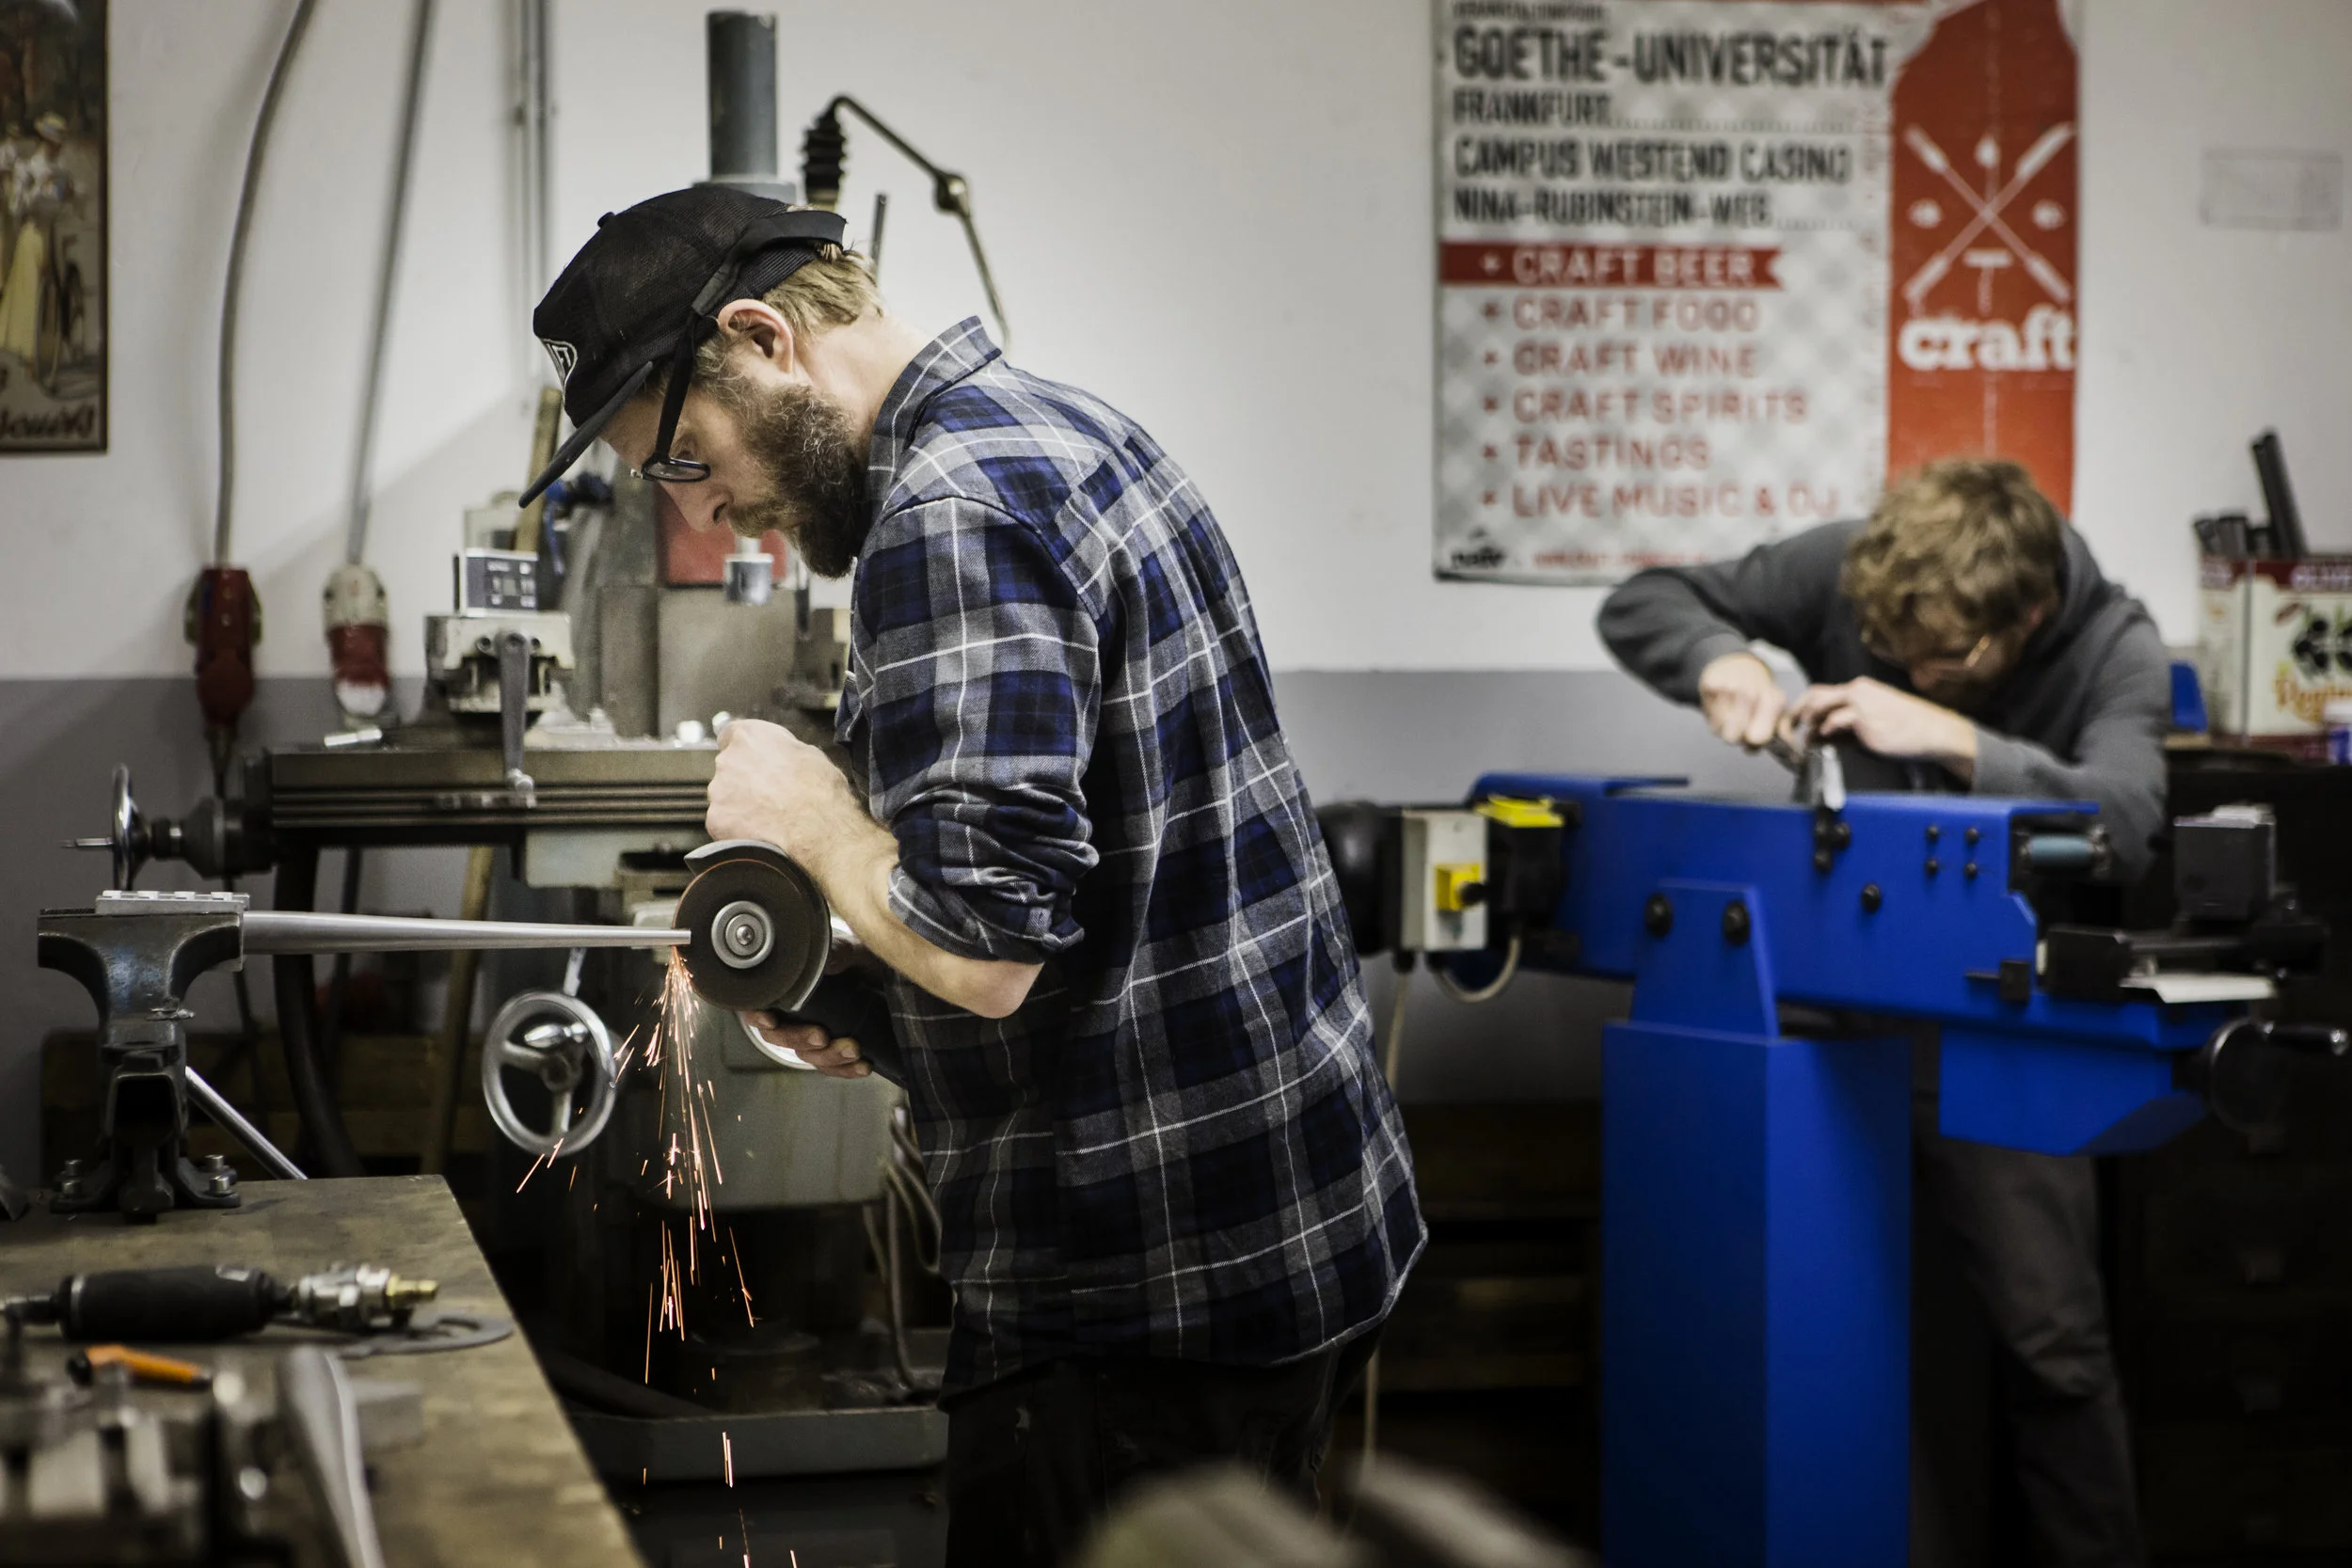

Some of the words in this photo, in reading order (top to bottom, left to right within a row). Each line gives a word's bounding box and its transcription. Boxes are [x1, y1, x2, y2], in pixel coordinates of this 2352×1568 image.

[1454, 24, 1887, 87] GOETHE-UNIVERSITÄT
[1454, 88, 1610, 126] FRANKFURT
[1454, 136, 1581, 180] CAMPUS
[1588, 139, 1730, 182] WESTEND
[1740, 142, 1851, 184] CASINO
[1513, 247, 1640, 283] CRAFT
[1653, 249, 1753, 286] BEER
[1513, 294, 1639, 330] CRAFT
[1652, 298, 1760, 332] FOOD
[1899, 303, 2074, 371] craft
[1513, 341, 1639, 375] CRAFT
[1652, 344, 1756, 378] WINE
[1513, 387, 1639, 423] CRAFT
[1651, 389, 1807, 425] SPIRITS
[1515, 435, 1711, 471] TASTINGS
[1513, 483, 1600, 517] LIVE
[1613, 483, 1740, 517] MUSIC
[1789, 483, 1838, 518] DJ
